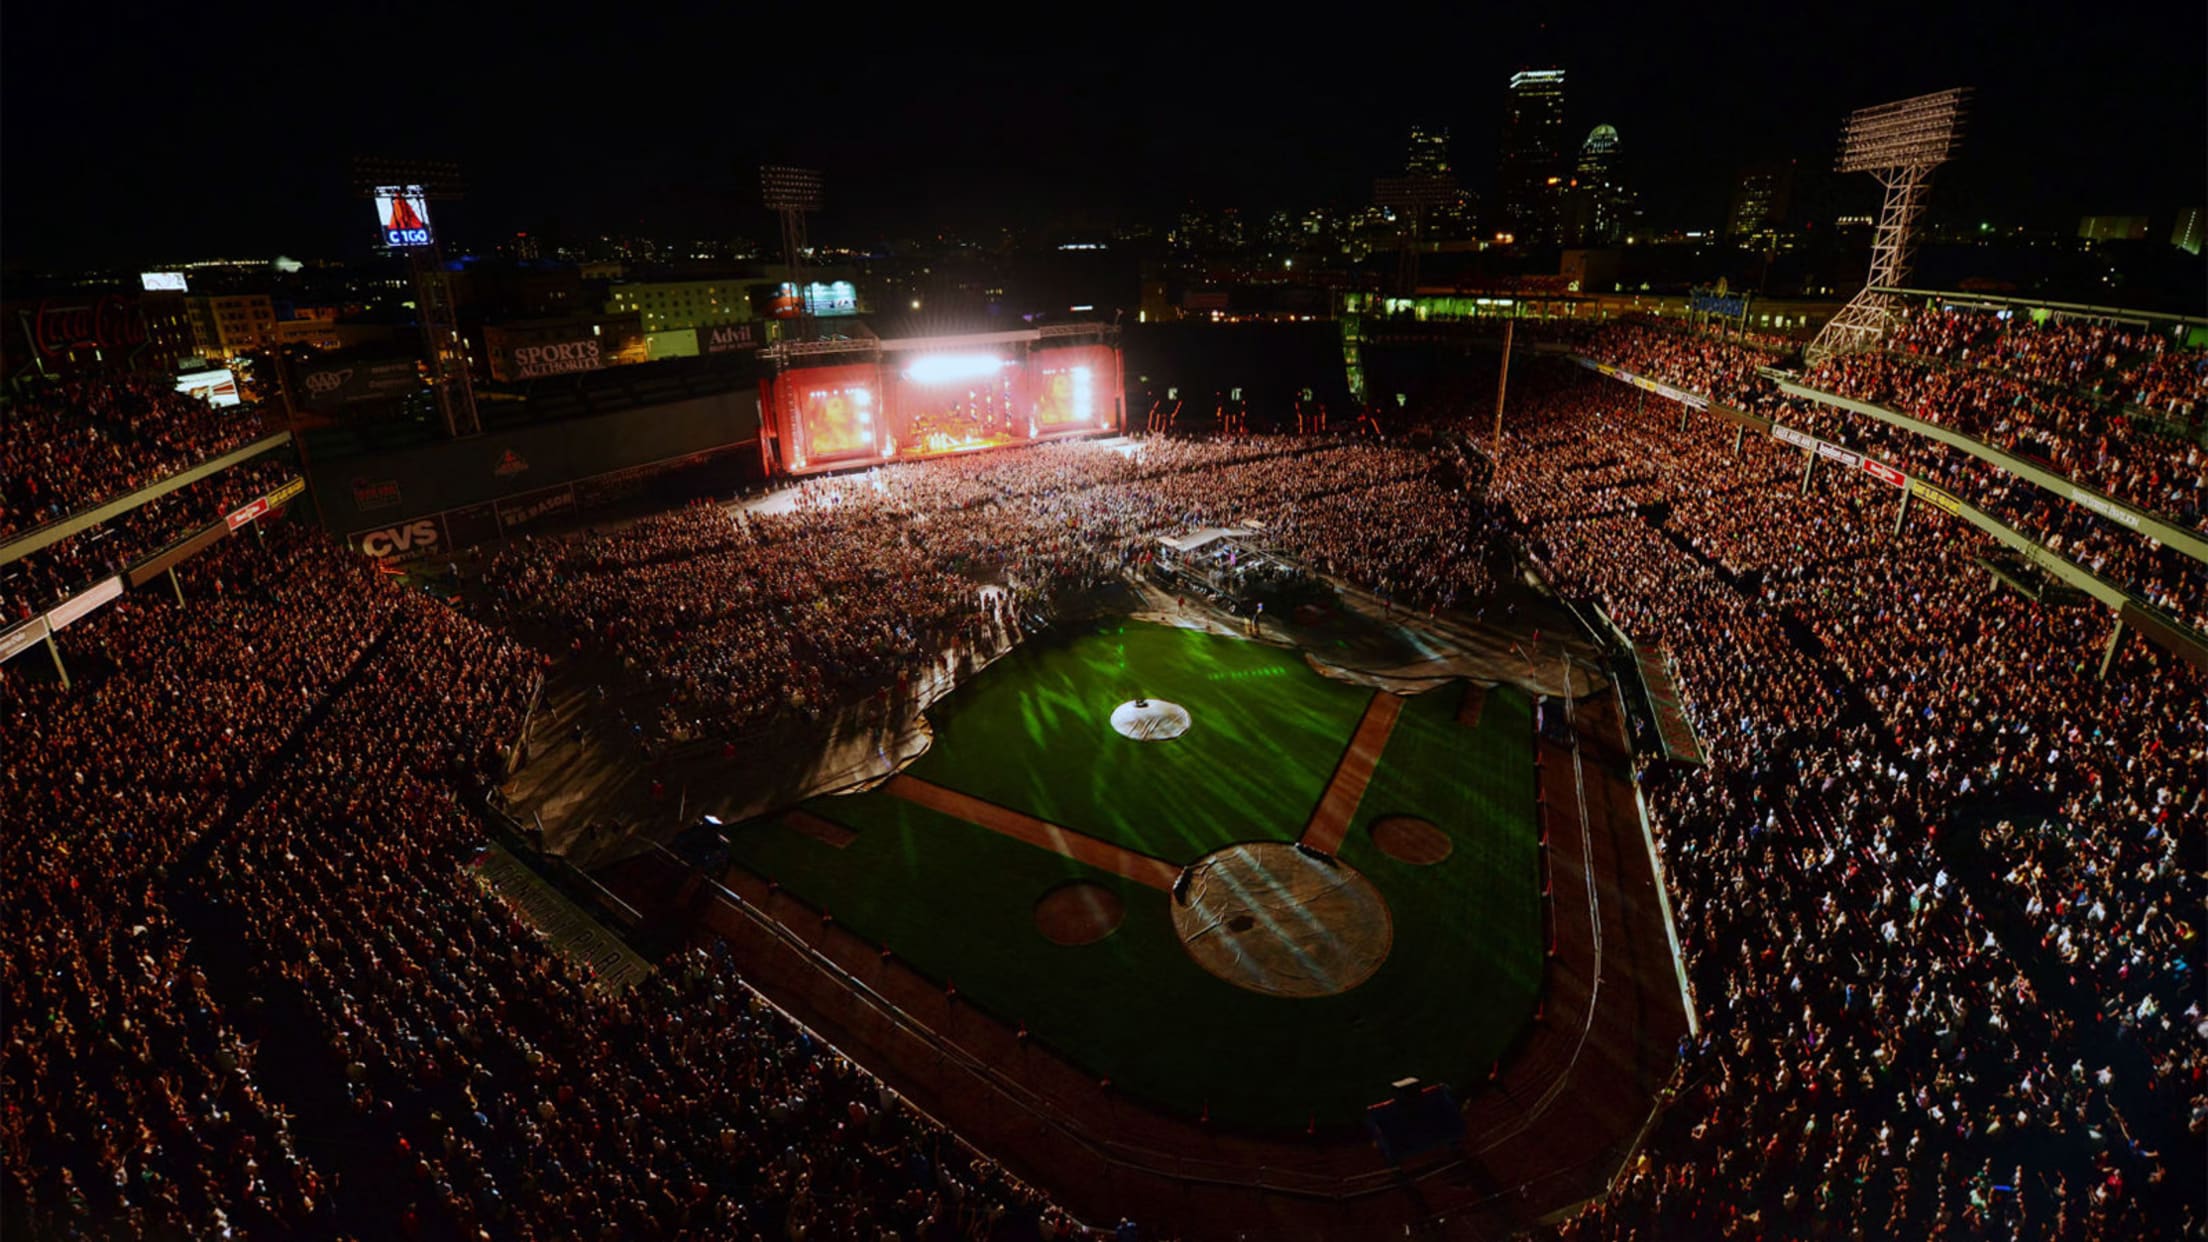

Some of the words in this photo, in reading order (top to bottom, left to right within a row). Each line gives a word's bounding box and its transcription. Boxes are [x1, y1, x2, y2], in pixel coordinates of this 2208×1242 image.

[388, 229, 429, 243] CTGO
[711, 325, 751, 343] Advil
[514, 340, 599, 366] SPORTS
[519, 356, 600, 378] AUTHORITY
[307, 372, 340, 391] AAA
[362, 520, 439, 557] CVS
